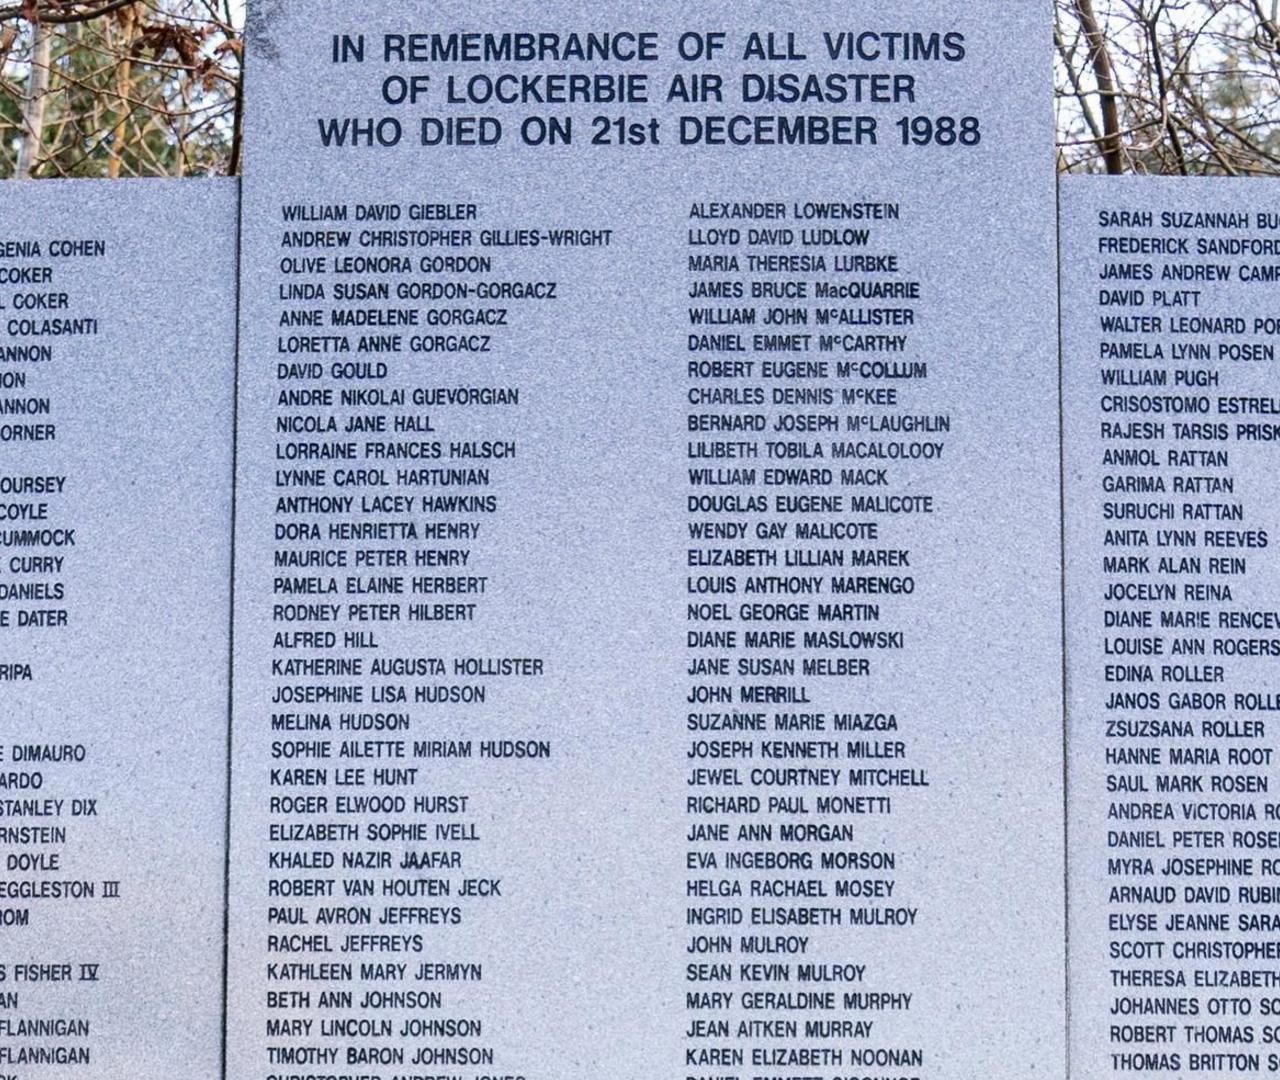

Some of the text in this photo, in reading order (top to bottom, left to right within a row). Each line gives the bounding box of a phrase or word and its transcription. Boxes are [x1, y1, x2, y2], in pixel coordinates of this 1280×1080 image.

[332, 31, 966, 63] IN REMEMBRANCE OF ALL VICTIMS
[381, 73, 915, 105] OF LOCKERBIE AIR DISASTER
[317, 115, 981, 147] WHO DIED ON 21st DECEMBER 1988
[281, 203, 477, 222] WILLIAM DAVID GIEBLER
[689, 202, 900, 220] ALEXANDER LOWENSTEIN
[1098, 210, 1153, 228] SARAH
[1160, 211, 1250, 229] SUZANNAH
[281, 229, 613, 248] ANDREW CHRISTOPHER GILLIES-WRIGHT
[688, 228, 871, 247] LLOYD DAVID LUDLOW
[1098, 236, 1189, 255] FREDERICK
[48, 239, 106, 258] COHEN
[279, 255, 492, 275] OLIVE LEONORA GORDON
[688, 254, 899, 273] MARIA THERESIA LURBKE
[1098, 289, 1201, 307] DAVID PLATT
[273, 631, 379, 649] ALFRED HILL
[1104, 664, 1225, 683] EDINA ROLLER
[686, 685, 811, 704] JOHN MERRILL
[270, 767, 419, 786] KAREN LEE HUNT
[1106, 774, 1268, 793] SAUL MARK ROSEN
[71, 798, 98, 817] DIX
[686, 823, 854, 843] JANE ANN MORGAN
[14, 963, 72, 982] FISHER
[78, 963, 100, 982] IV
[1109, 1025, 1177, 1044] ROBERT
[1184, 1025, 1255, 1044] THOMAS
